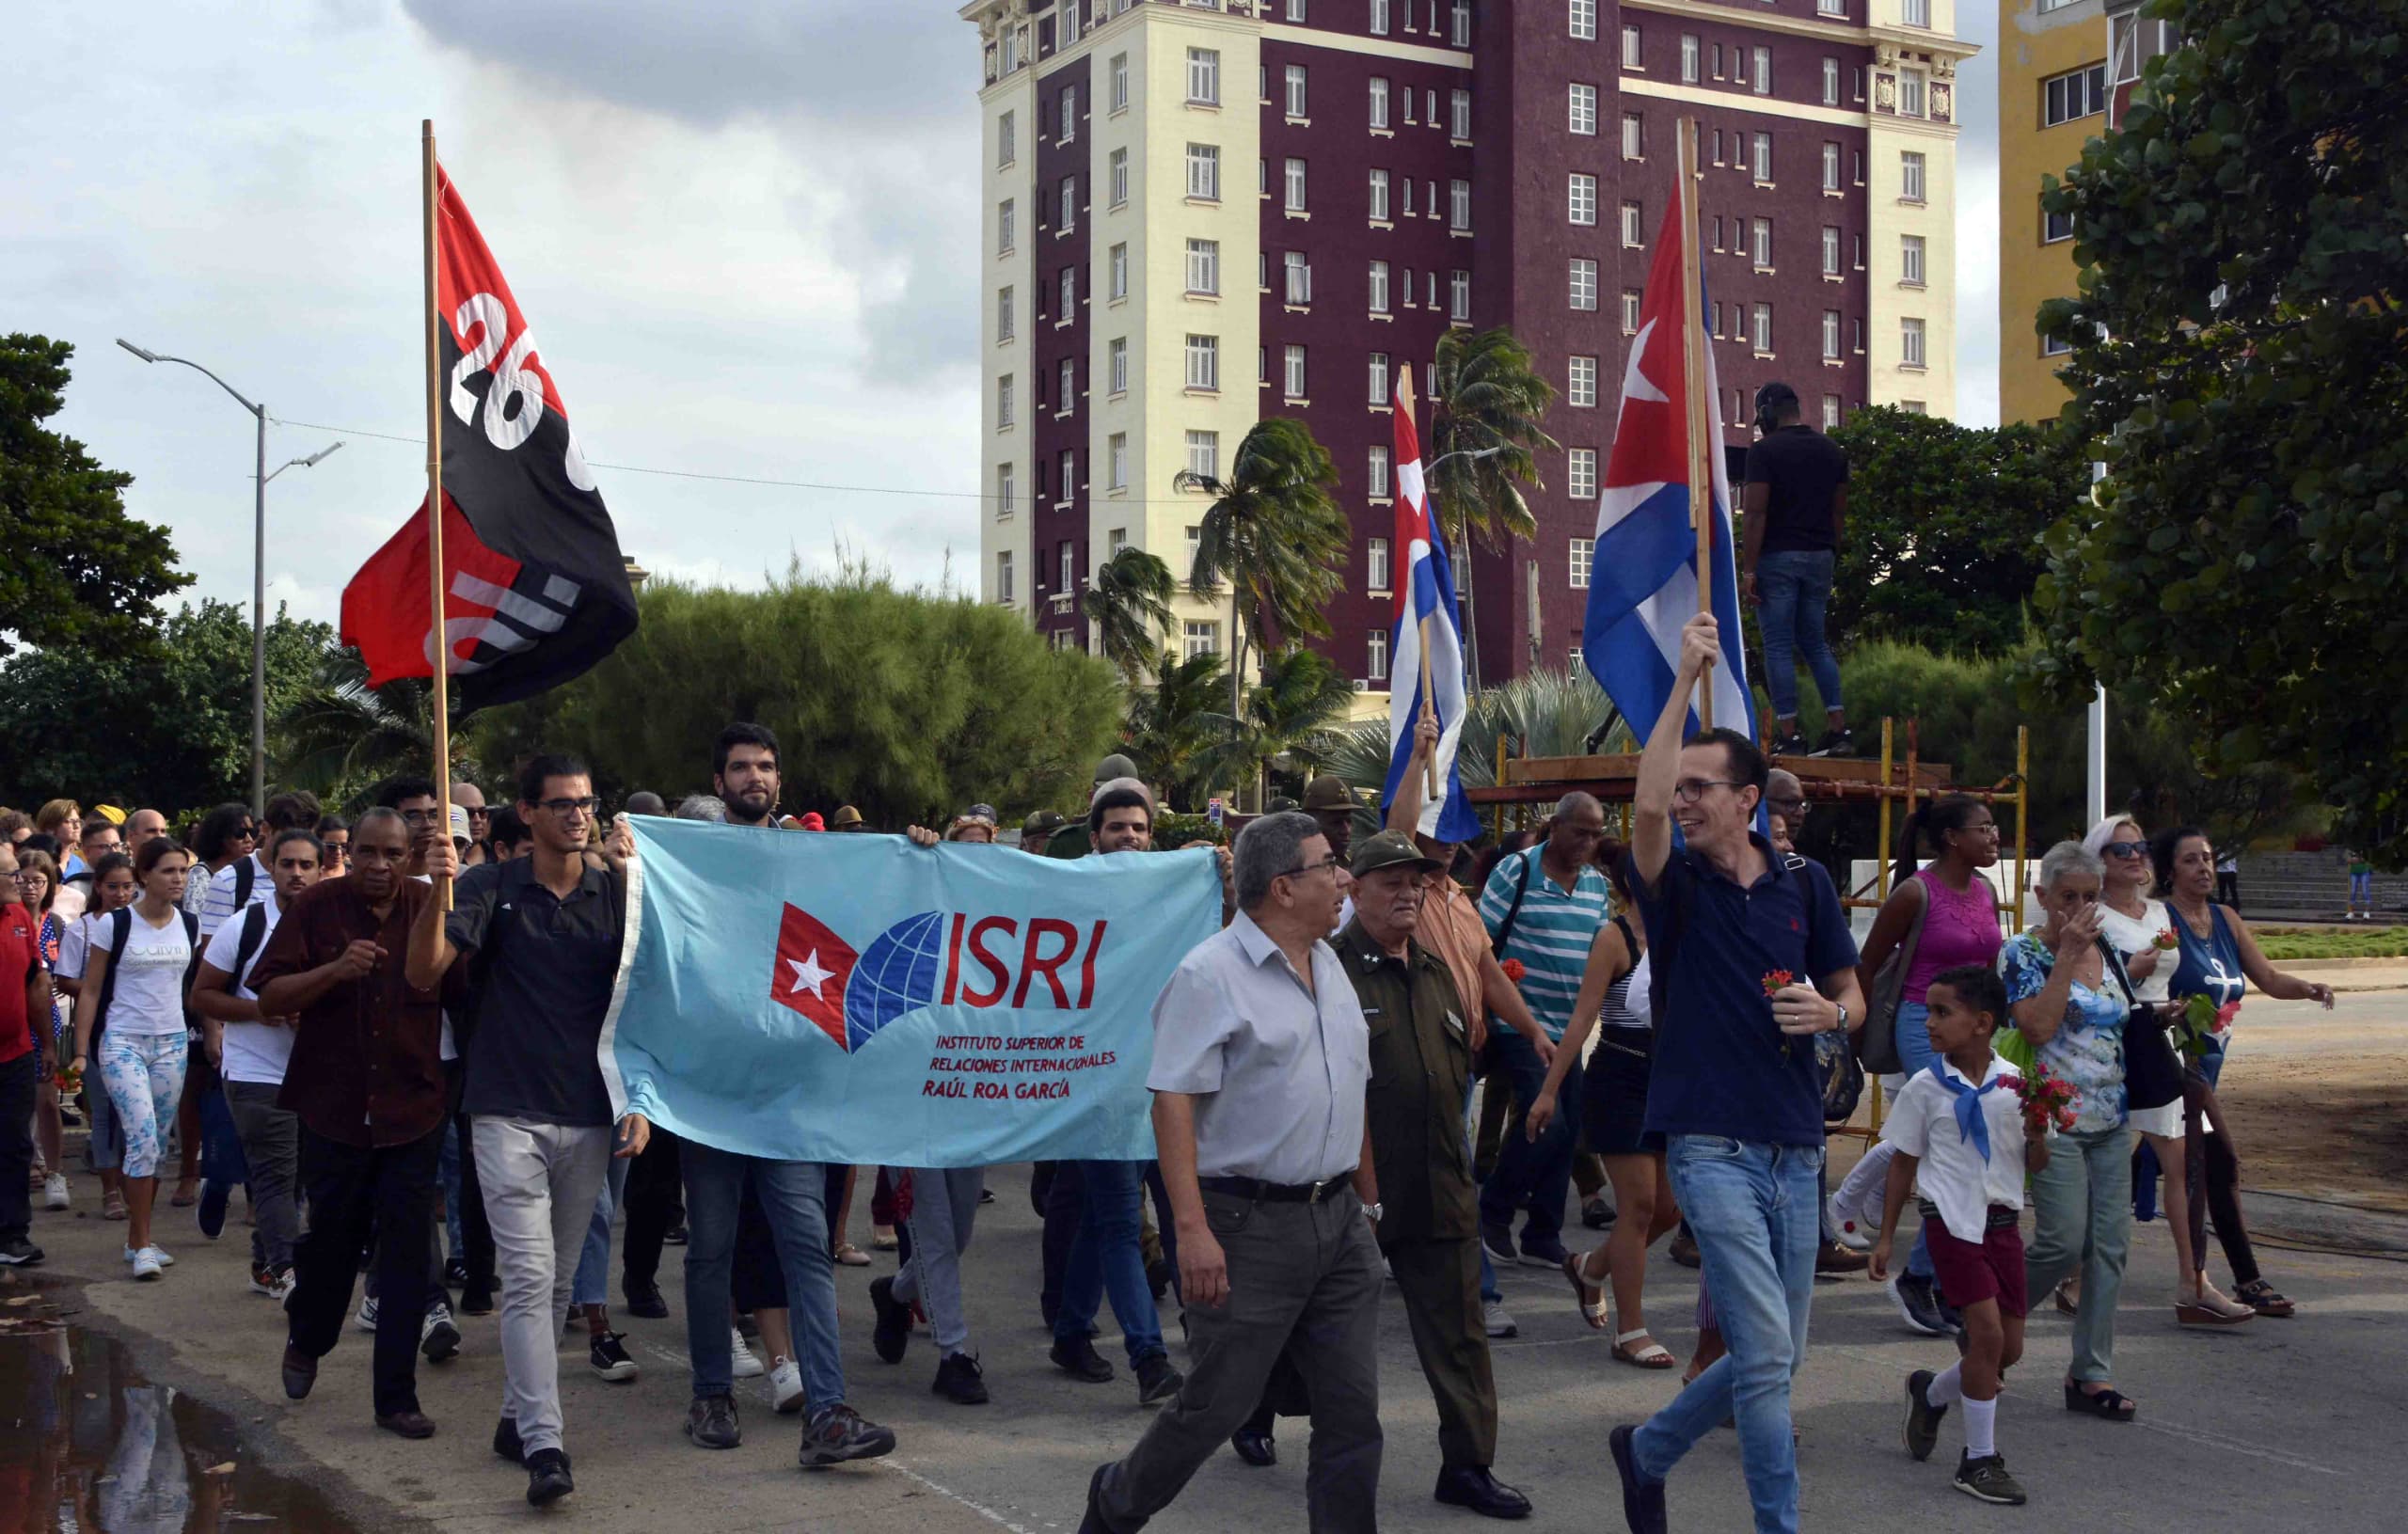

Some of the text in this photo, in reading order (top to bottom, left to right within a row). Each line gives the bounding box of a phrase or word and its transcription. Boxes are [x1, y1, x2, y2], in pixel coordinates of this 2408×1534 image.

[450, 293, 545, 451] 26
[941, 911, 1108, 1010] ISRI
[936, 1036, 1085, 1051] INSTITUTO SUPERIOR DE
[929, 1052, 1116, 1073] RELACIONES INTERNACIONALES
[922, 1077, 1070, 1099] RAÚL ROA GARCÍA
